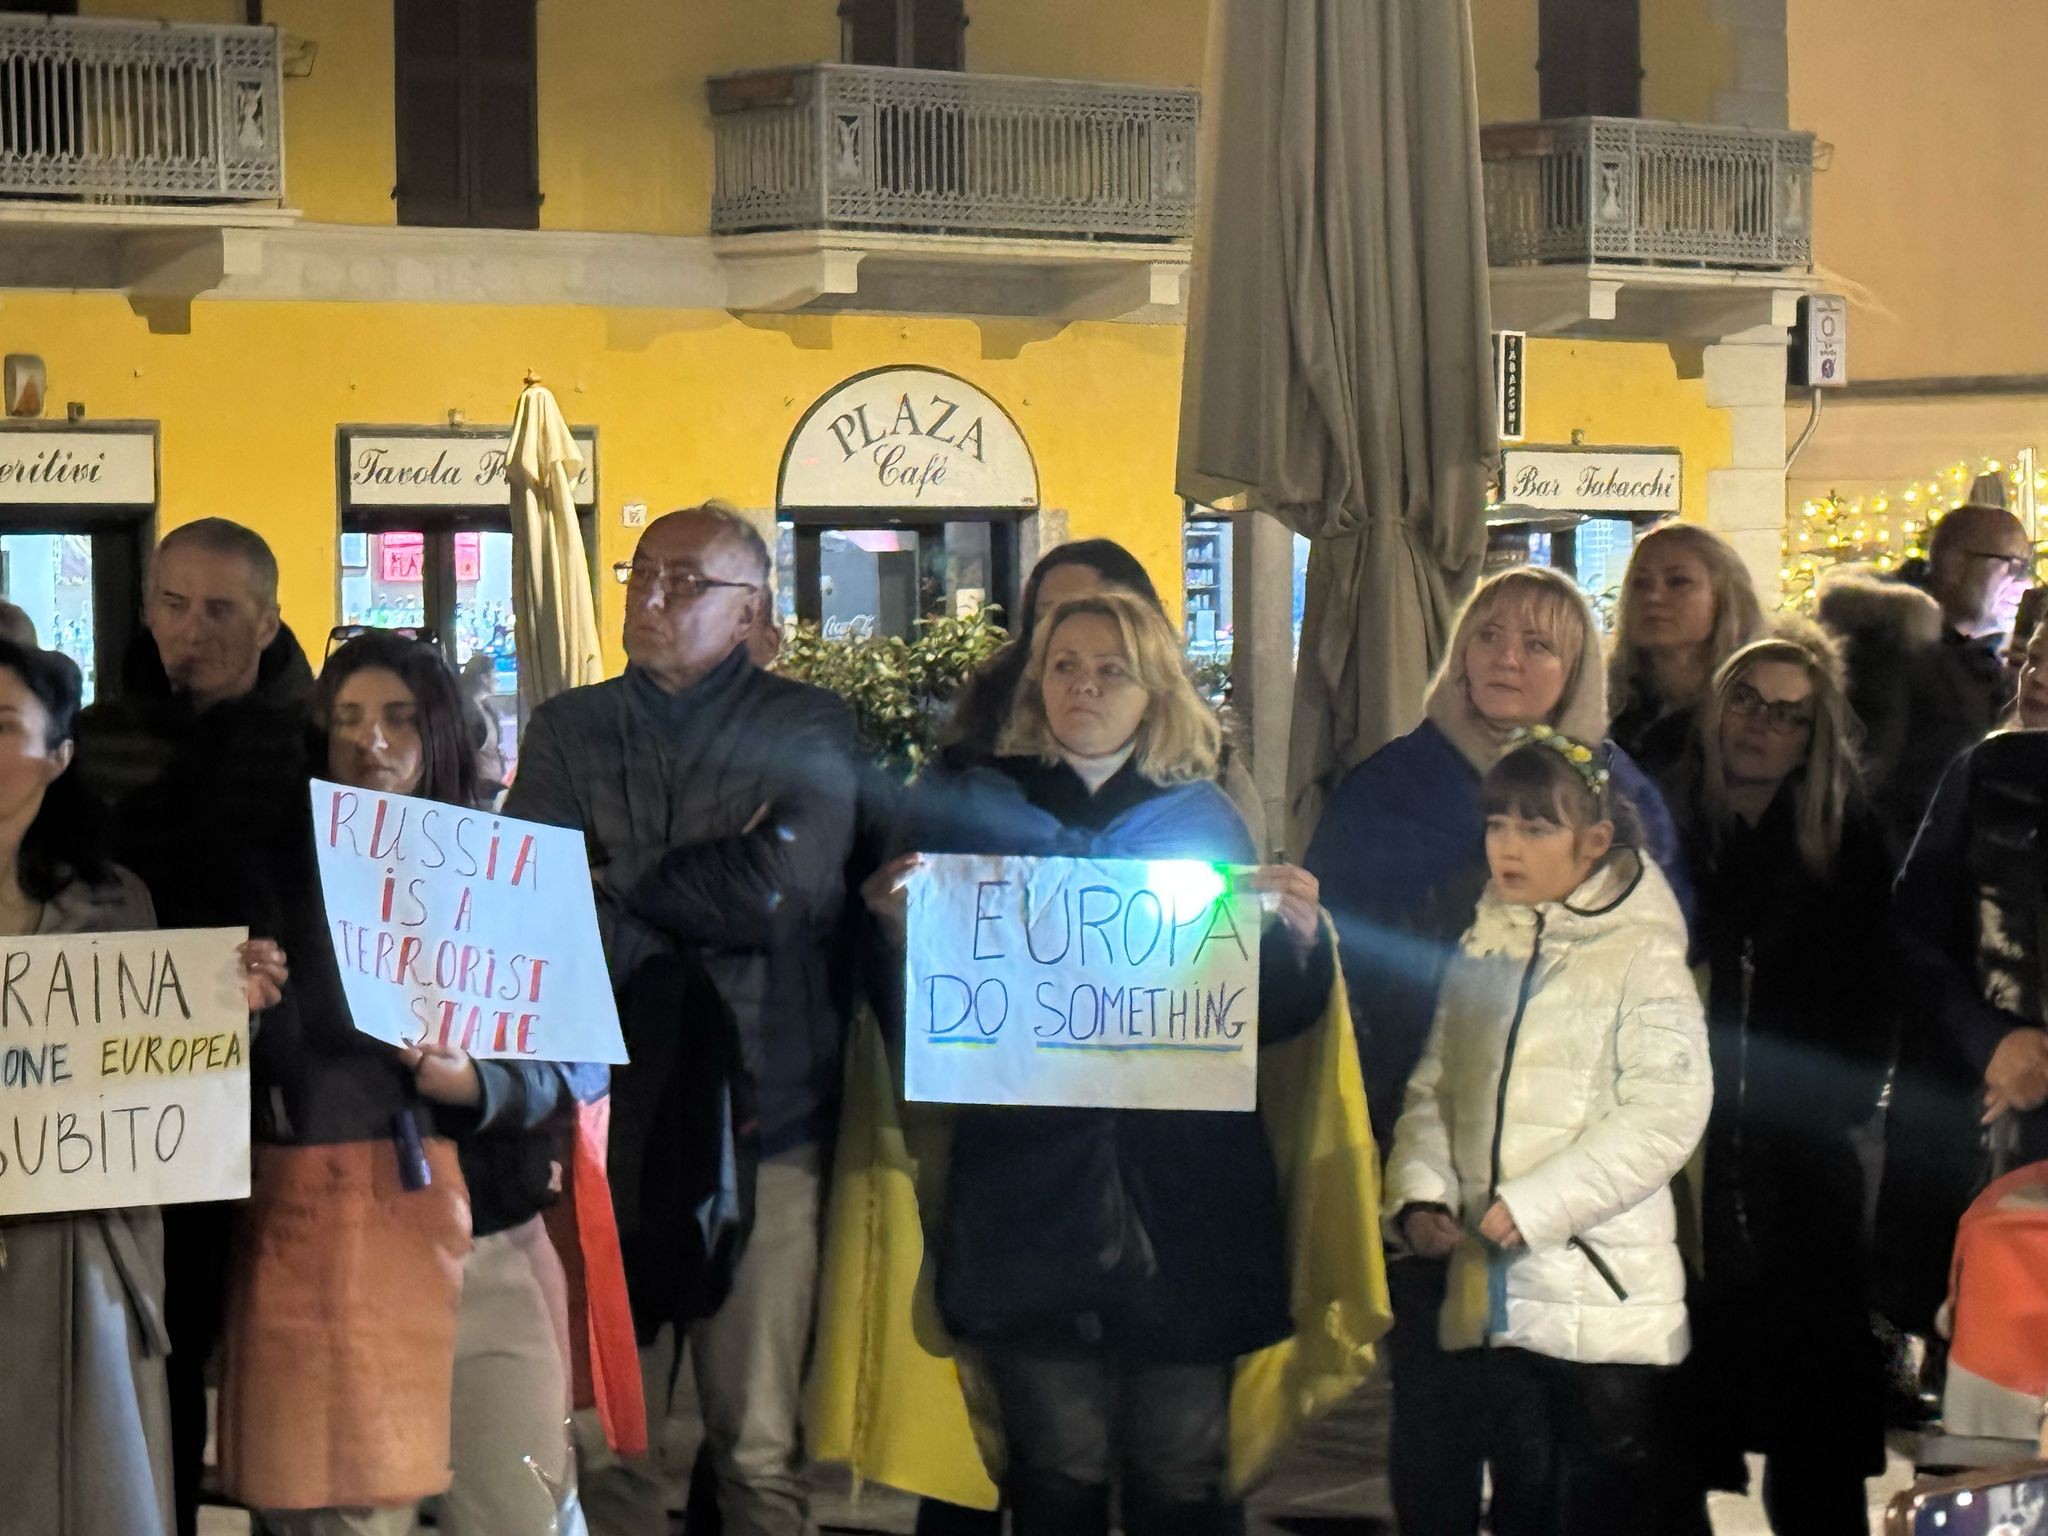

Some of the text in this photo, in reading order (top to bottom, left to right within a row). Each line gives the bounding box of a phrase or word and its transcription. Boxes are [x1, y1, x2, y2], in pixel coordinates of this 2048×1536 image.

[1508, 337, 1517, 434] TABACCHI
[826, 392, 986, 463] PLAZA
[353, 448, 462, 486] Tavola
[873, 443, 949, 499] Café
[1512, 464, 1675, 498] Bar Tabacchi
[330, 791, 538, 891] RUSSIA
[454, 886, 472, 933] A
[973, 880, 1249, 967] EUROPA
[400, 996, 541, 1055] STATE
[923, 974, 1009, 1037] DO
[4, 1030, 242, 1089] ONE EUROPEA
